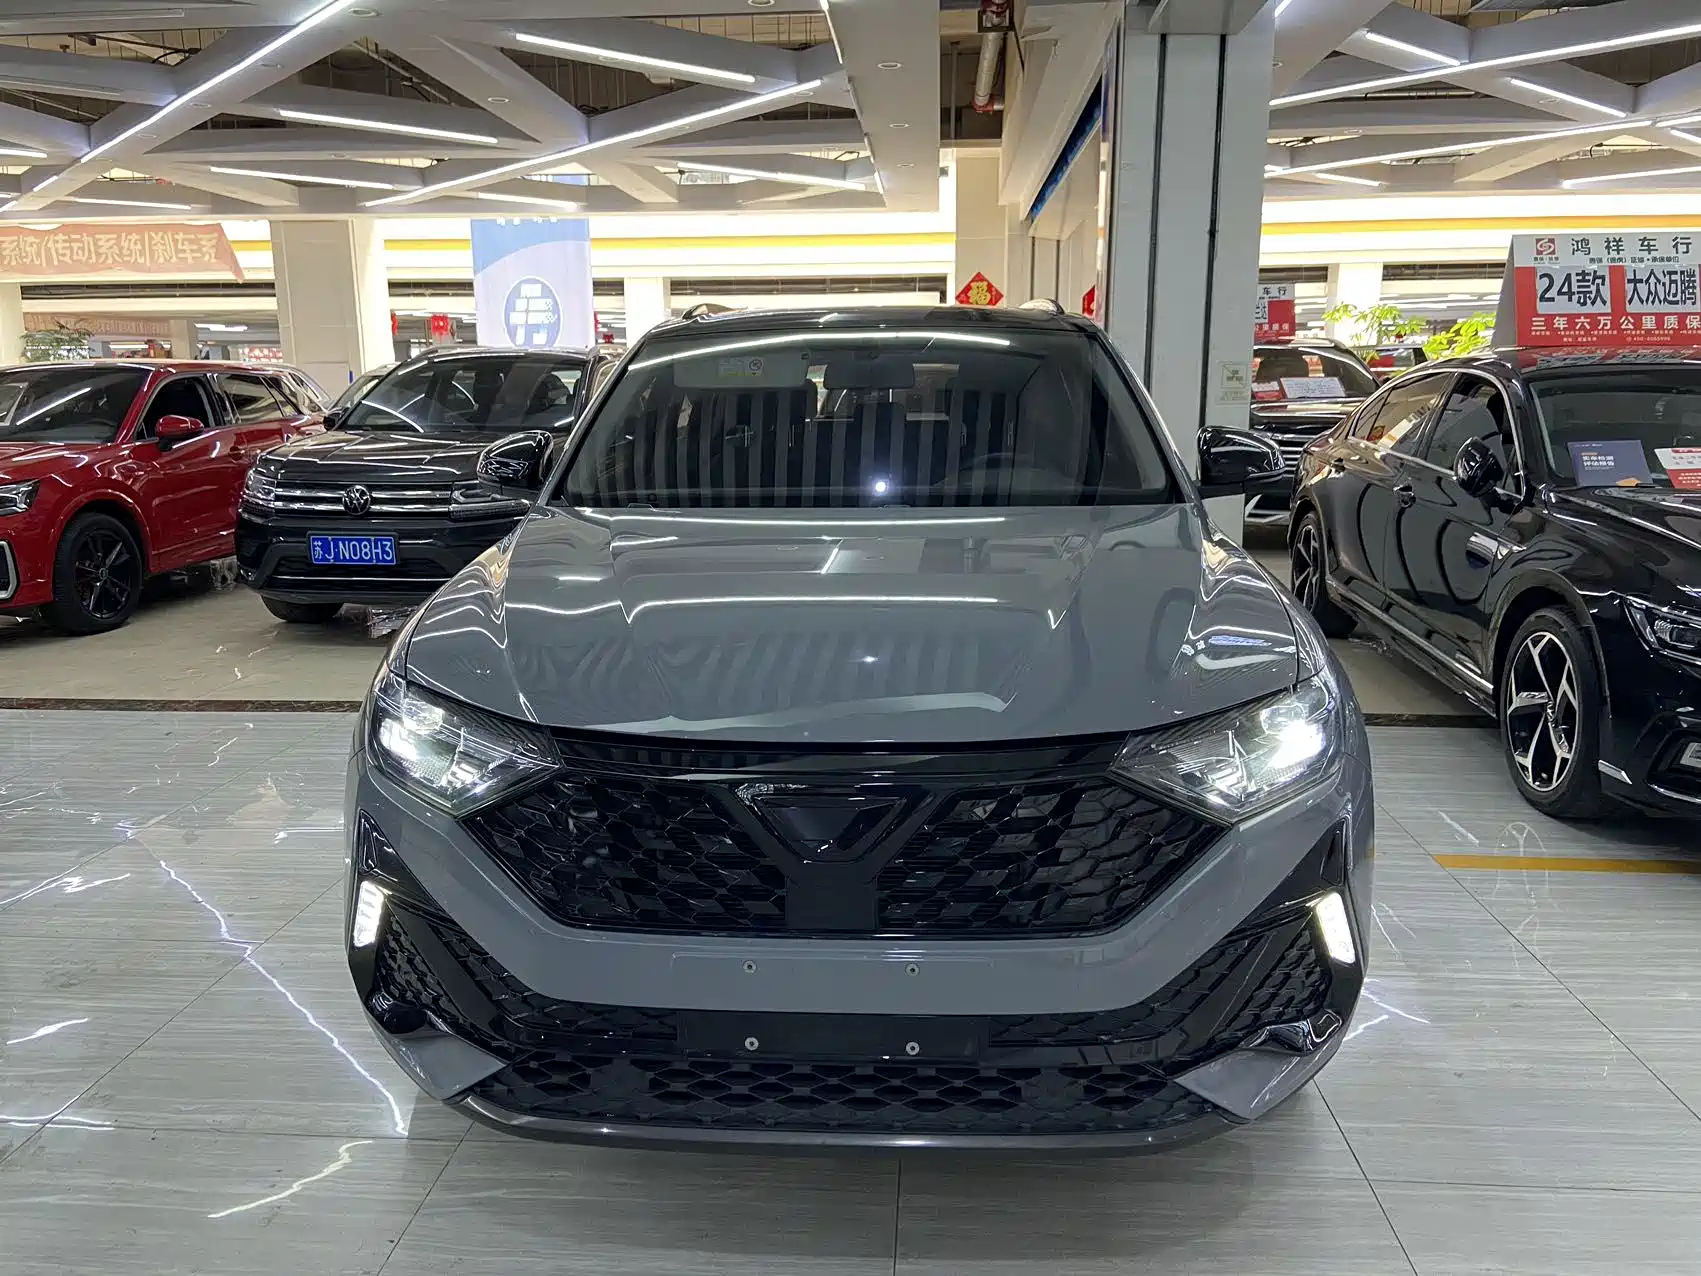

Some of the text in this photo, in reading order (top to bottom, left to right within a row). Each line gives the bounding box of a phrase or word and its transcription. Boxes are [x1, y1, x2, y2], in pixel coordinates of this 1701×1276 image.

[1571, 236, 1692, 256] 鸿祥车行
[968, 281, 991, 305] 福
[1538, 268, 1697, 307] 24款 大众迈腾
[1531, 315, 1701, 330] 三年六万公里质保
